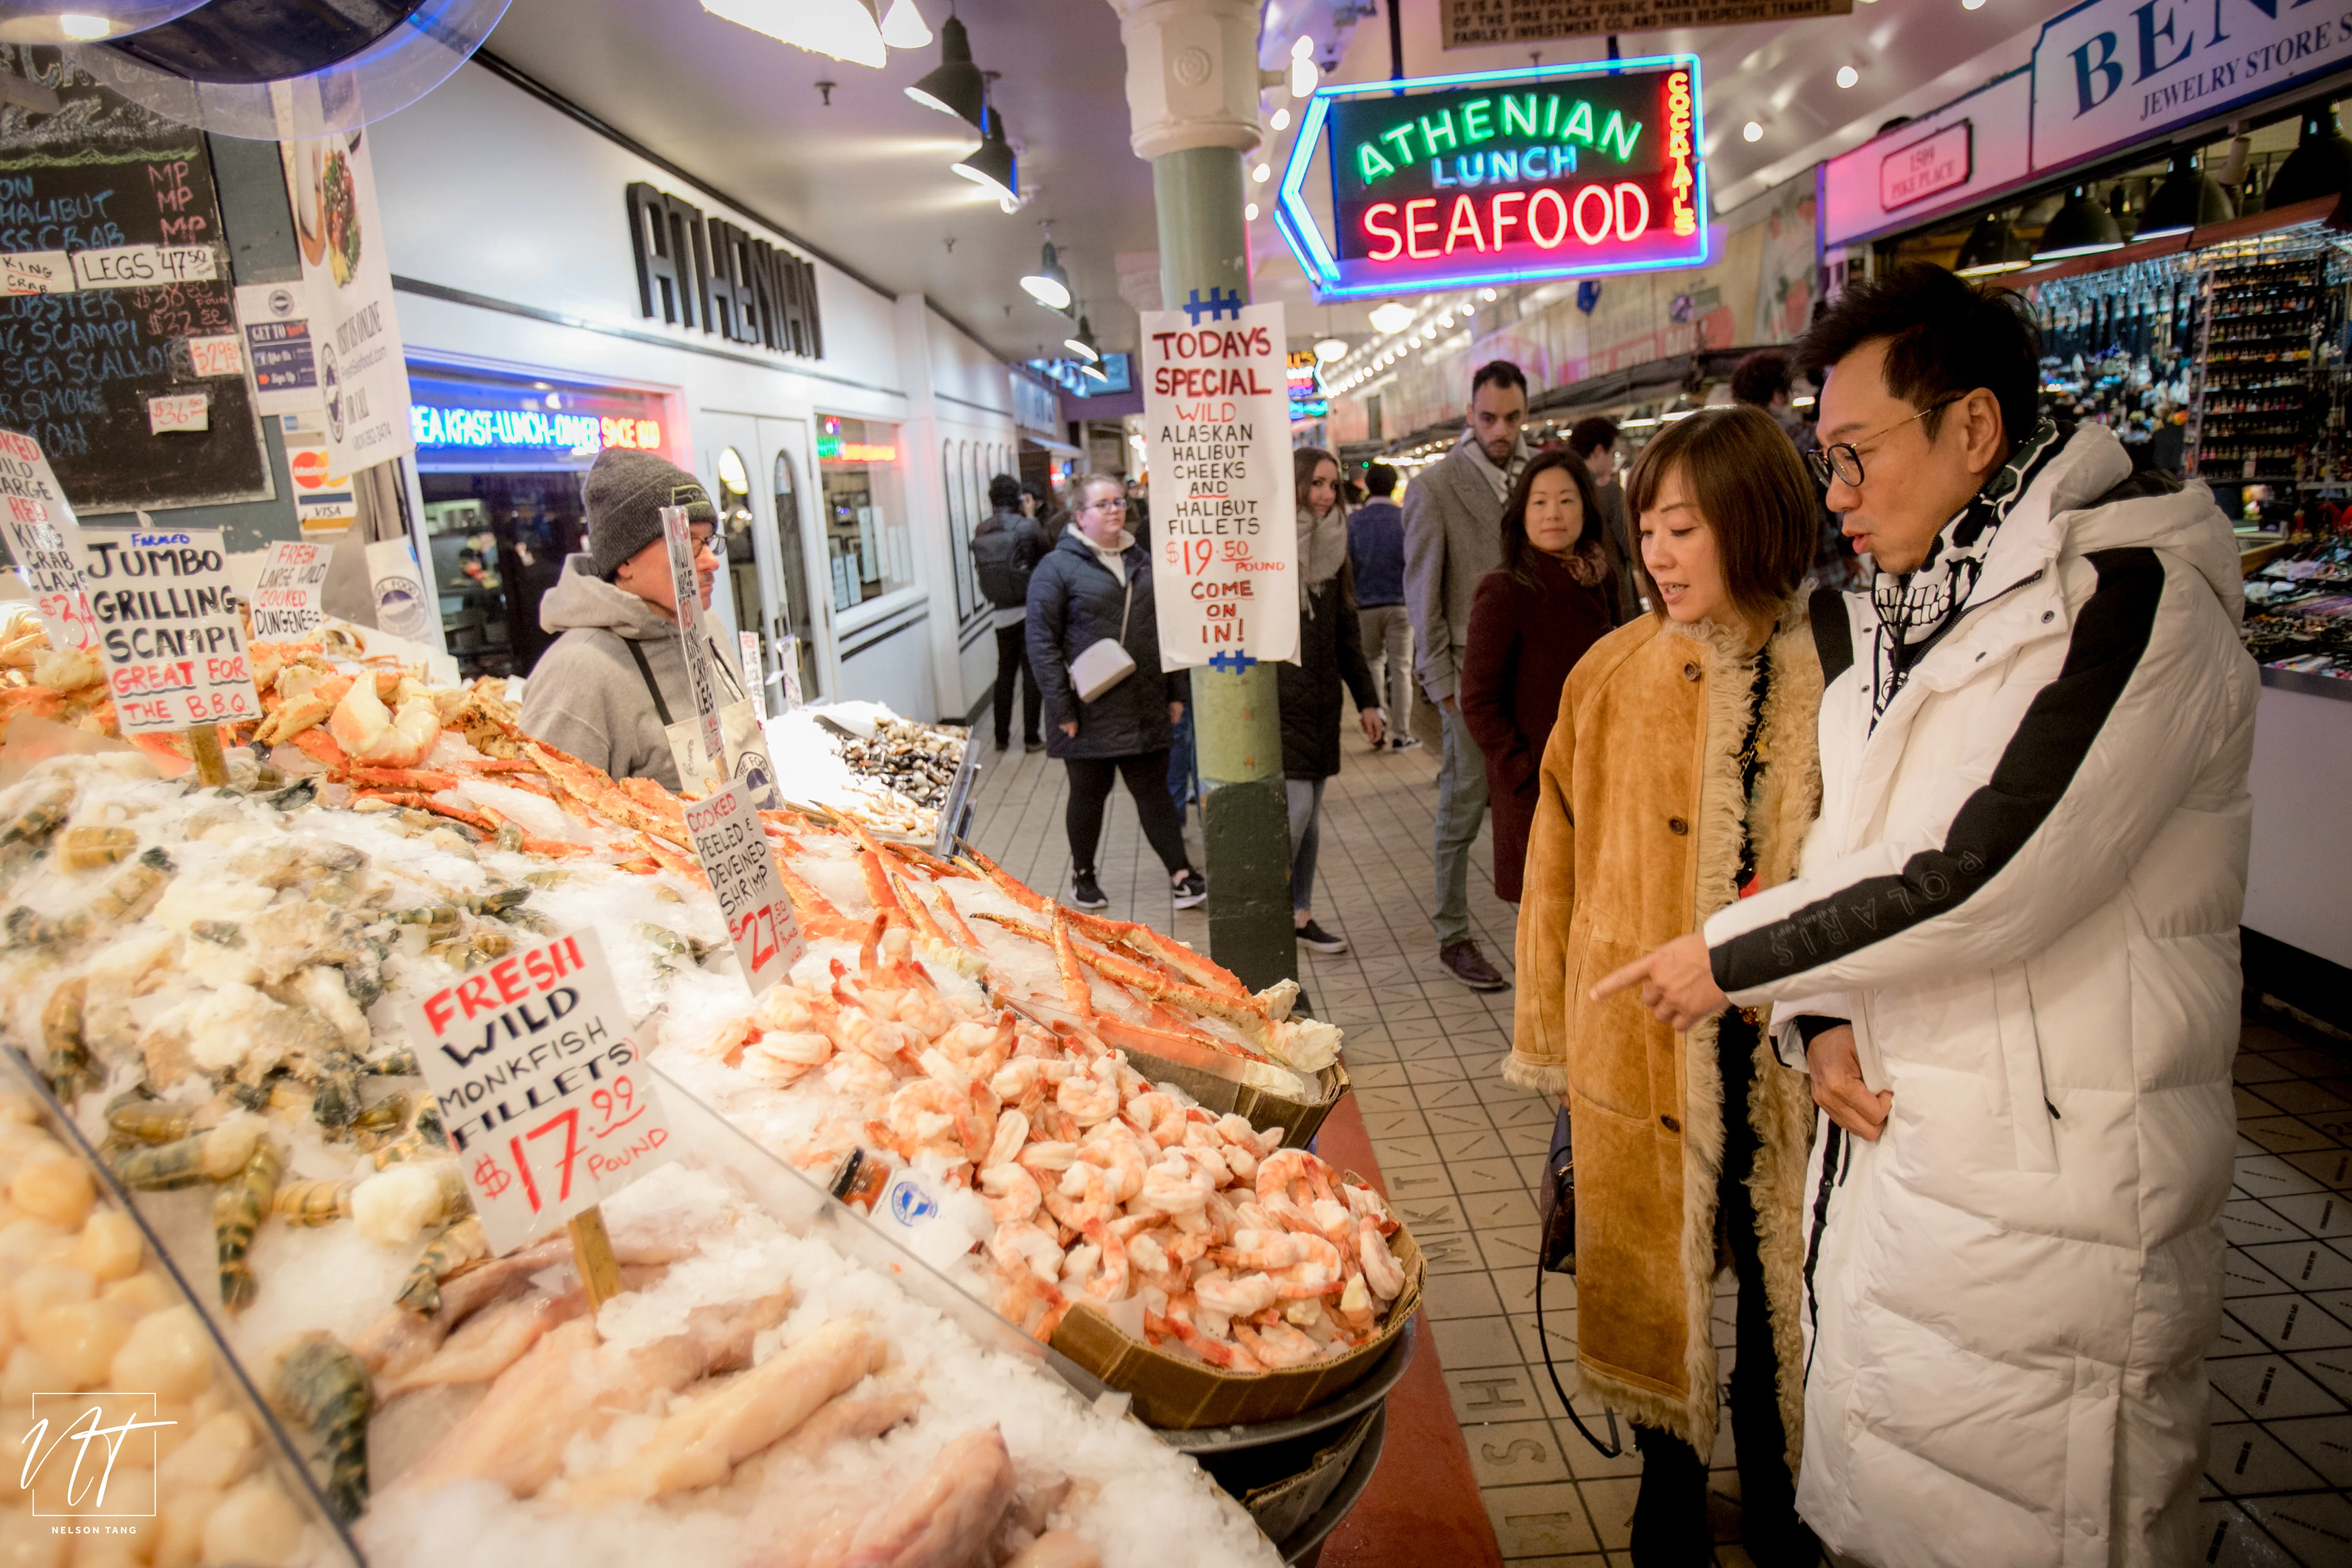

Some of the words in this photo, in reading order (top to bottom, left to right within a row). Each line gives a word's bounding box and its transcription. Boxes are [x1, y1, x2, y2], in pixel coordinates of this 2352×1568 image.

[1479, 14, 1504, 26] THE
[1548, 6, 1592, 20] PLACE
[1514, 19, 1599, 38] INVESTMENT
[2067, 0, 2315, 120] BEN
[2139, 57, 2241, 122] JEWELRY
[2244, 22, 2332, 79] STORE
[1358, 92, 1643, 186] ATHENIAN
[1432, 144, 1578, 189] LUNCH
[1667, 71, 1697, 238] COCKTAILS
[1918, 160, 1955, 188] PLACE
[1363, 180, 1650, 262] SEAFOOD
[3, 256, 53, 278] KING
[82, 253, 155, 282] LEGS
[626, 181, 825, 361] ATHENIAN
[8, 275, 48, 294] CRAB
[30, 319, 140, 354] SCAMPI
[1152, 326, 1272, 360] TODAYS
[3, 356, 62, 386] SEA
[1154, 366, 1273, 399] SPECIAL
[1176, 402, 1236, 424] WILD
[1161, 424, 1253, 443] ALASKAN
[1173, 444, 1250, 462] HALIBUT
[1174, 461, 1246, 479] CHEEKS
[1190, 481, 1228, 496] AND
[7, 496, 48, 523] RED
[314, 505, 342, 517] VISA
[1176, 500, 1259, 517] HALIBUT
[10, 522, 64, 550] KING
[1168, 518, 1260, 536] FILLETS
[26, 551, 75, 572] CRAB
[86, 541, 224, 580] JUMBO
[277, 544, 319, 565] FRESH
[1235, 561, 1285, 573] POUND
[257, 568, 295, 589] LARGE
[297, 563, 326, 585] WILD
[1190, 580, 1254, 600] COME
[93, 584, 241, 624] GRILLING
[259, 589, 307, 608] COOKED
[1206, 603, 1236, 618] ON
[254, 609, 322, 635] DUNGENESS
[1202, 619, 1245, 644] IN!
[104, 625, 241, 664] SCAMPI
[112, 661, 195, 694] GREAT
[206, 656, 248, 679] FOR
[123, 699, 172, 720] THE
[687, 793, 738, 833] COOKED
[696, 823, 744, 862] PEELED
[707, 840, 766, 890] DEVEINED
[720, 864, 768, 916] SHRIMP
[423, 935, 587, 1038] FRESH
[440, 986, 581, 1069] WILD
[436, 1015, 608, 1119] MONKFISH
[452, 1042, 634, 1152] FILLETS
[587, 1127, 669, 1180] POUND
